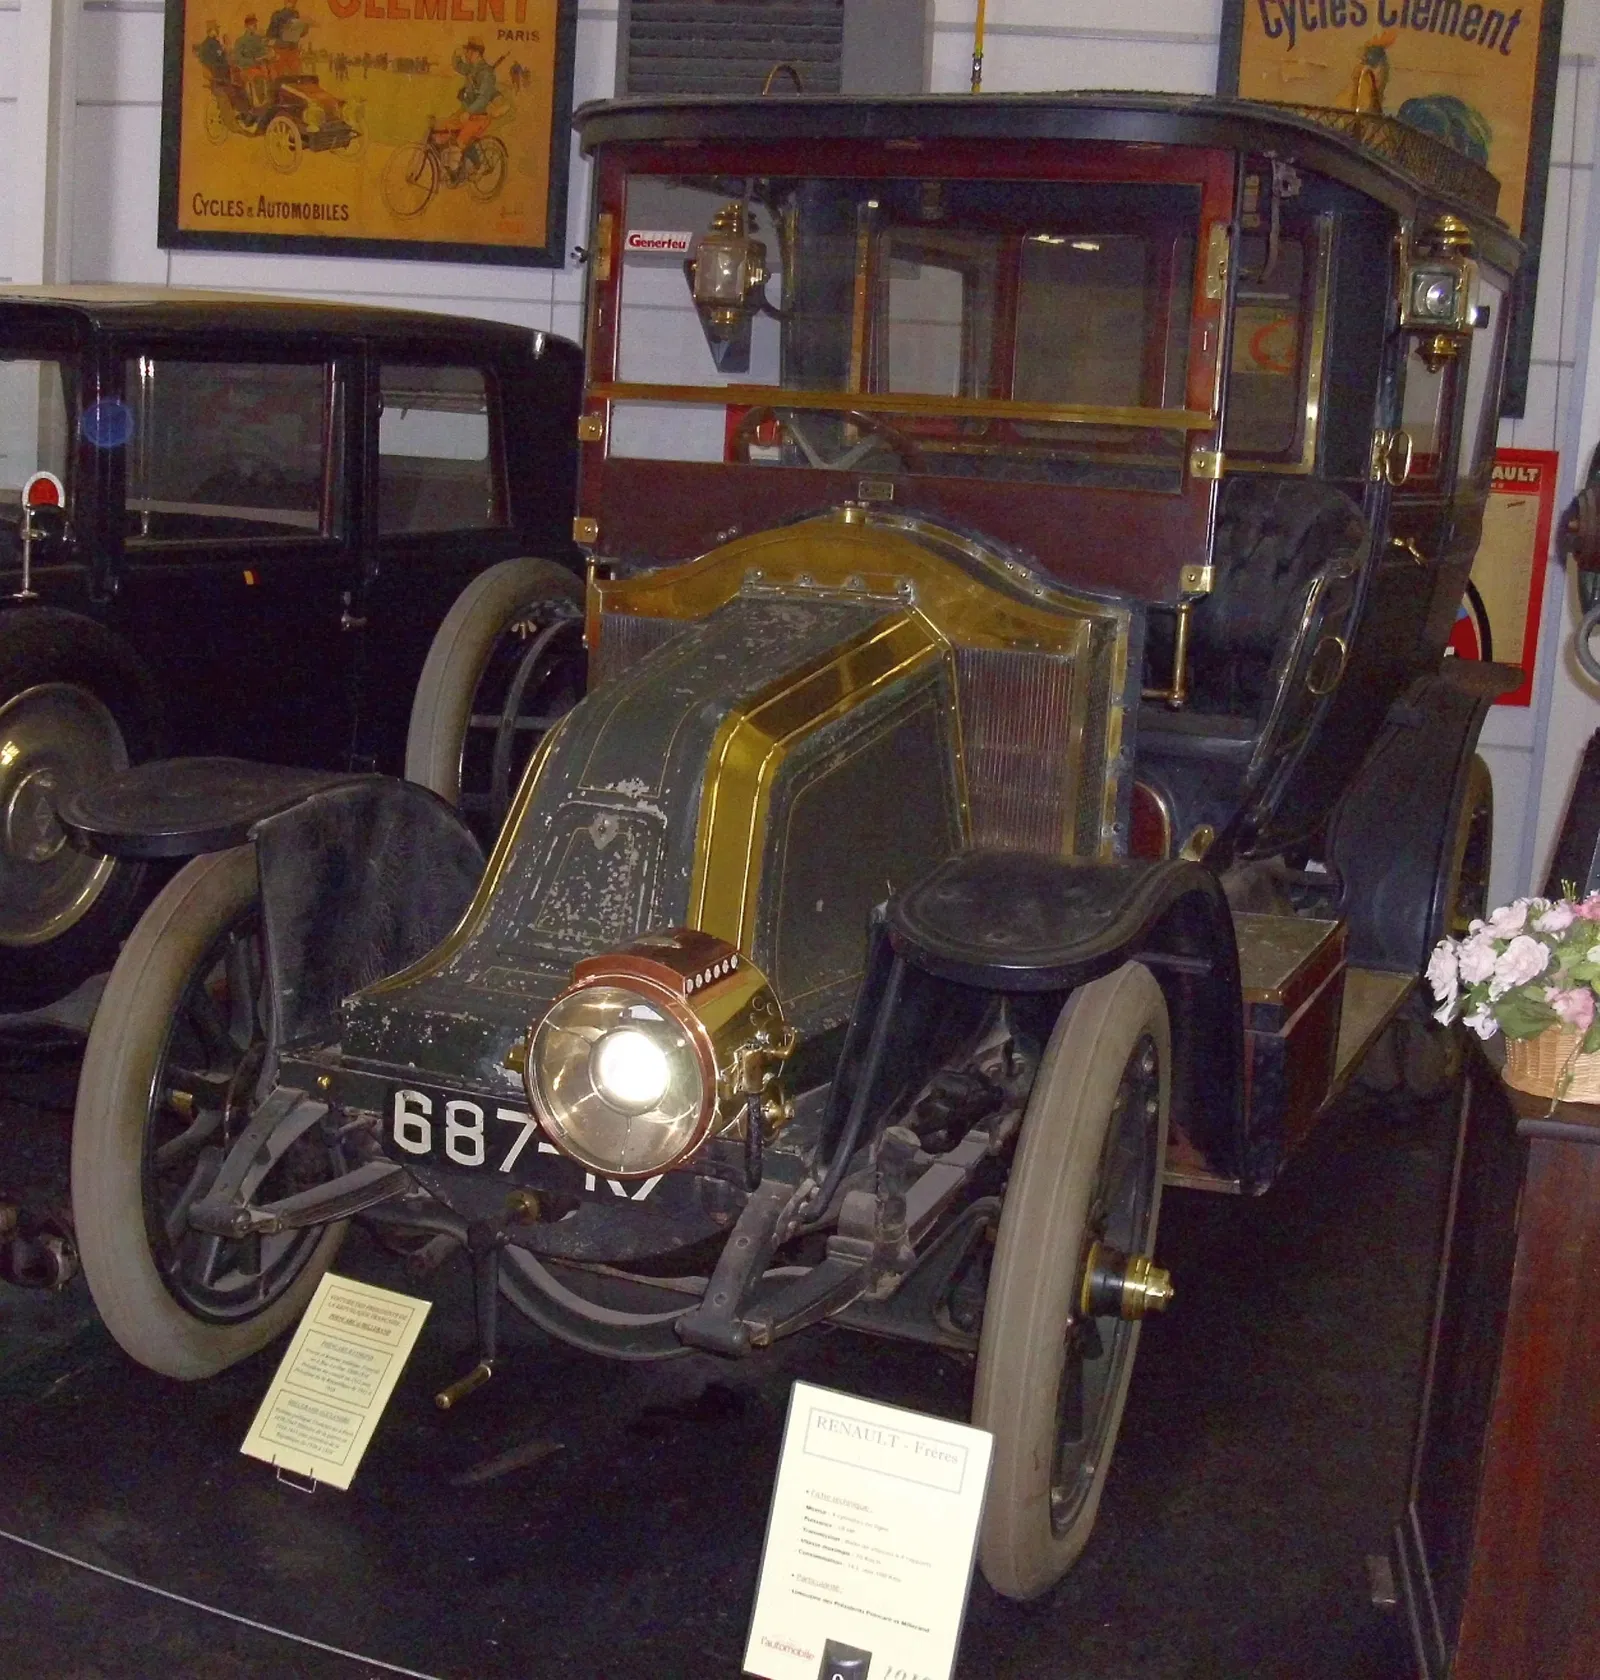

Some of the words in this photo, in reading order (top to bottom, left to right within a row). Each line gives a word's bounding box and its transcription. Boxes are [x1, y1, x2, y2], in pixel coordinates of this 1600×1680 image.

[497, 29, 540, 42] PARIS
[257, 194, 349, 222] AUTOMOBILES
[629, 234, 686, 250] Generfeu
[816, 1415, 900, 1448] RENAULT
